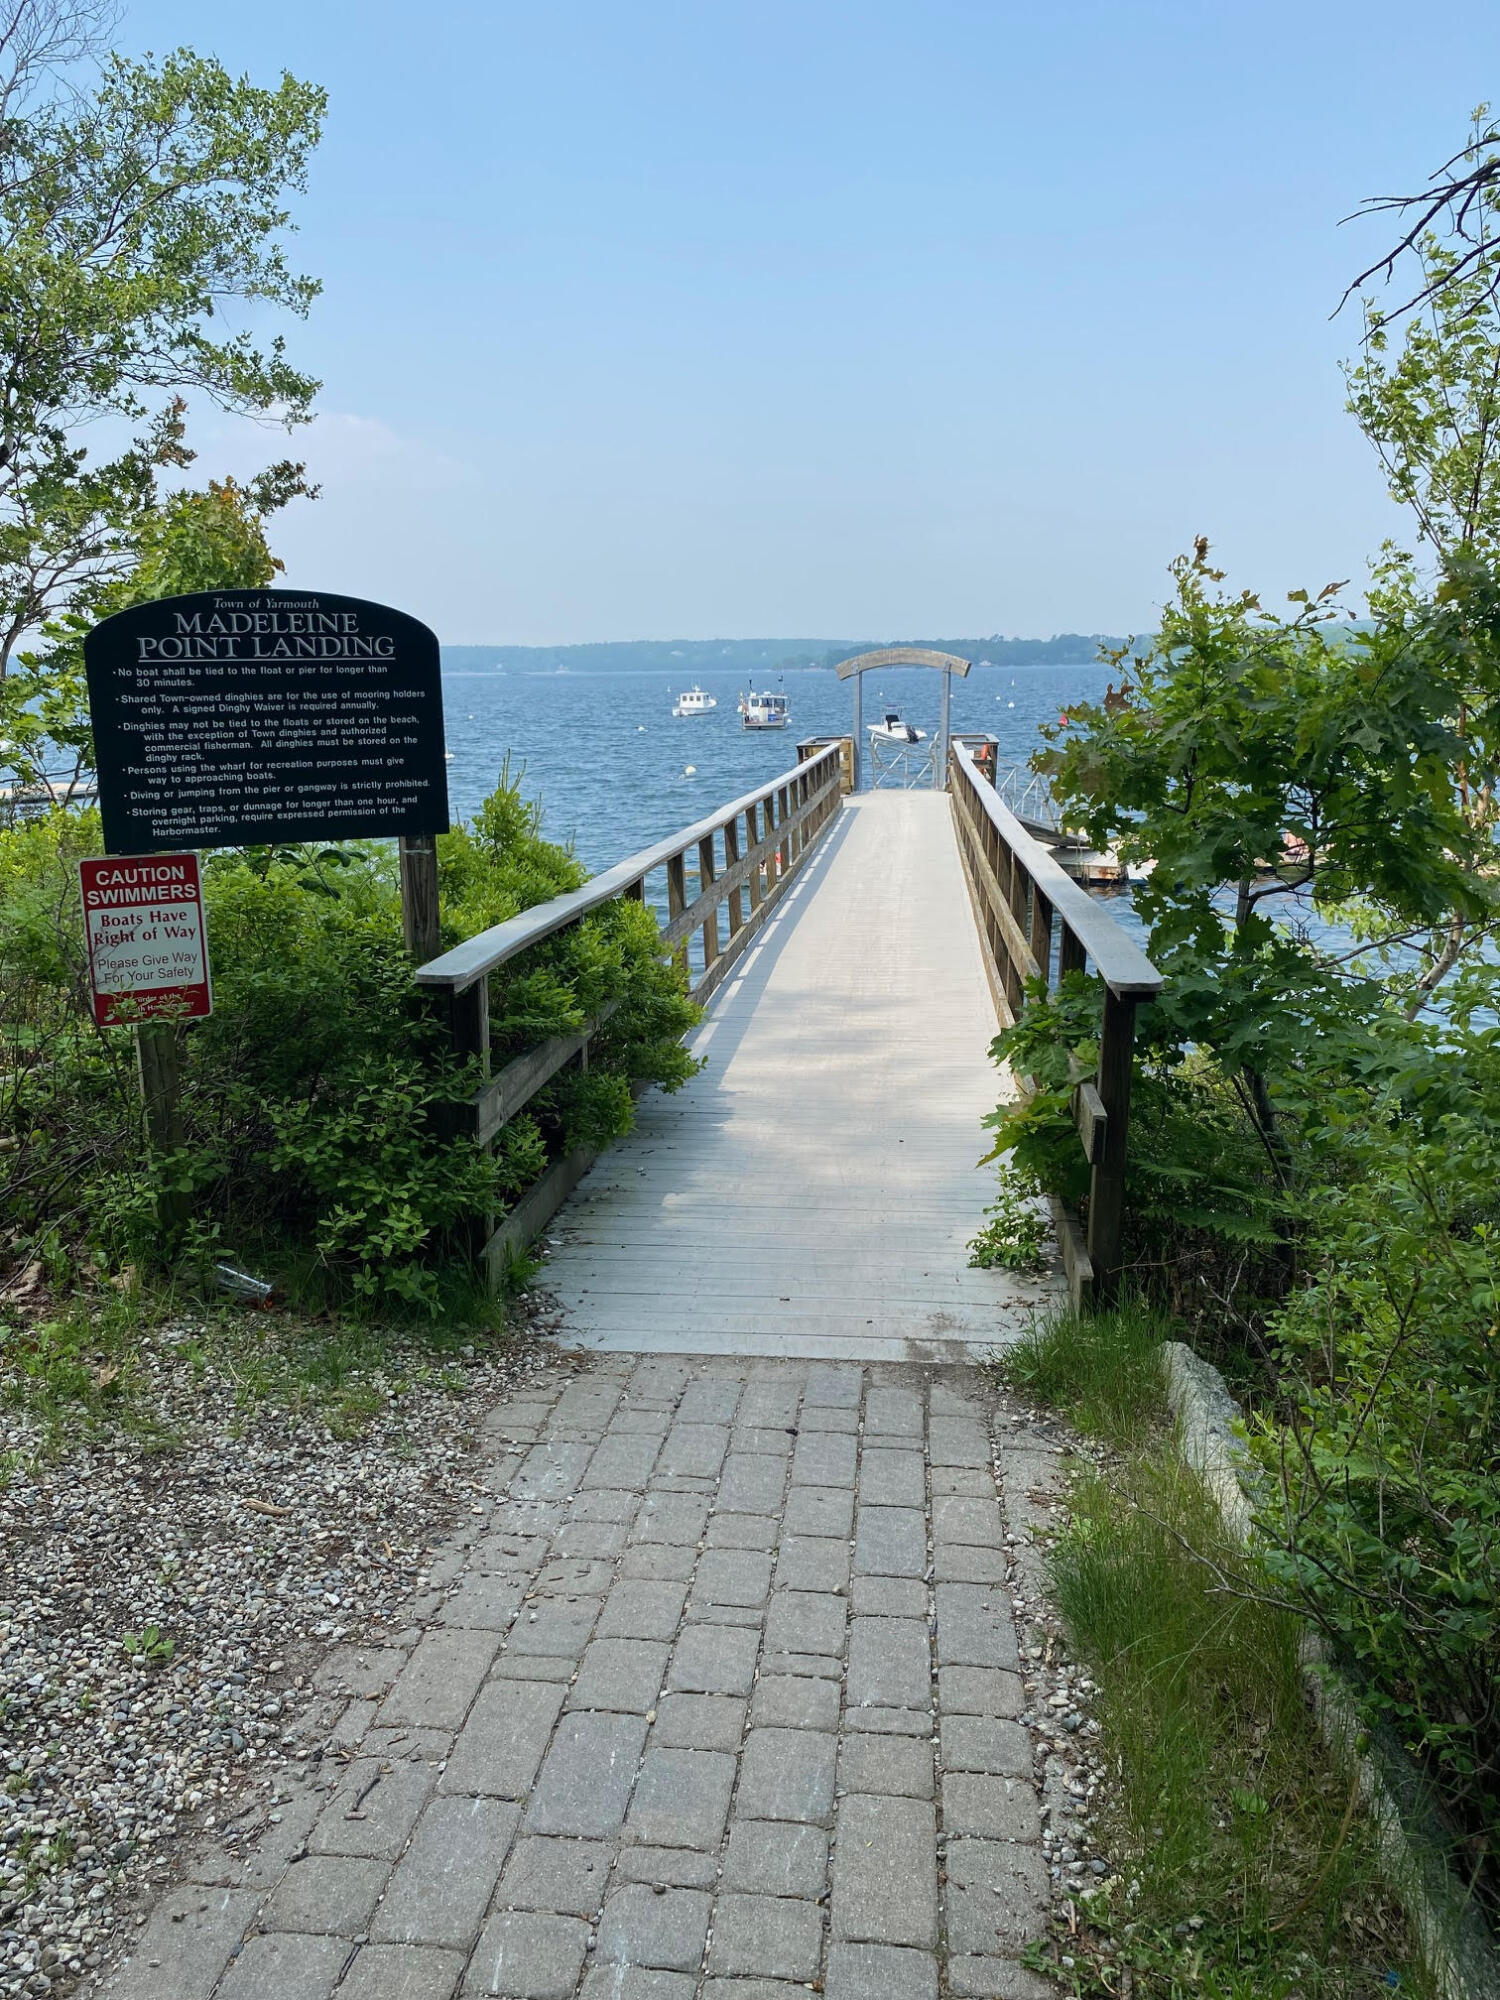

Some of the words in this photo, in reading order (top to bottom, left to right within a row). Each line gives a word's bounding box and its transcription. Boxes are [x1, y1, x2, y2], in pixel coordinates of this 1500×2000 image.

[215, 597, 244, 608] Town
[248, 599, 260, 608] of
[266, 598, 319, 609] Yarmouth
[172, 613, 359, 634] MADELEINE
[136, 637, 241, 658] POINT
[251, 636, 395, 657] LANDING
[118, 668, 133, 677] No
[135, 667, 159, 677] boat
[162, 667, 186, 676] shall
[188, 667, 202, 676] be
[205, 667, 224, 675] tied
[227, 667, 238, 675] to
[241, 666, 257, 675] the
[260, 666, 282, 675] float
[298, 667, 316, 675] pier
[319, 666, 333, 674] for
[336, 665, 365, 675] longer
[367, 665, 388, 673] than
[136, 678, 150, 687] 30
[153, 678, 195, 687] minutes.
[120, 694, 157, 704] Shared
[159, 693, 221, 702] Town-owned
[224, 692, 264, 702] dinghies
[286, 692, 300, 700] for
[341, 691, 351, 699] of
[354, 691, 390, 700] mooring
[393, 690, 426, 698] holders
[140, 705, 165, 715] only.
[172, 705, 180, 713] A
[183, 704, 216, 714] signed
[218, 703, 251, 714] Dinghy
[253, 703, 285, 711] Waiver
[299, 702, 337, 711] required
[340, 701, 379, 710] annually.
[123, 721, 166, 732] Dinghies
[169, 722, 190, 730] may
[192, 720, 209, 729] not
[212, 720, 225, 728] be
[228, 719, 247, 728] tied
[250, 719, 261, 727] to
[263, 718, 279, 727] the
[282, 718, 310, 726] floats
[326, 716, 355, 725] stored
[373, 716, 388, 724] the
[390, 715, 420, 724] beach,
[143, 730, 165, 741] with
[167, 732, 184, 741] the
[187, 730, 235, 741] exception
[238, 729, 248, 738] of
[251, 729, 276, 738] Town
[278, 728, 317, 738] dinghies
[319, 727, 337, 736] and
[340, 726, 387, 735] authorized
[144, 742, 201, 752] commercial
[203, 741, 253, 750] fisherman.
[260, 740, 273, 748] All
[275, 739, 314, 749] dinghies
[316, 738, 340, 746] must
[342, 738, 354, 746] be
[357, 736, 387, 745] stored
[403, 736, 418, 744] the
[127, 766, 168, 775] Persons
[170, 764, 197, 774] using
[200, 763, 216, 772] the
[219, 762, 246, 771] wharf
[249, 761, 264, 770] for
[266, 760, 313, 769] recreation
[316, 759, 359, 768] purposes
[386, 757, 405, 767] give
[145, 753, 178, 764] dinghy
[181, 752, 205, 761] rack.
[147, 777, 167, 786] way
[170, 775, 182, 784] to
[184, 773, 244, 784] approaching
[246, 772, 276, 780] boats.
[130, 791, 161, 801] Diving
[178, 788, 216, 799] jumping
[218, 787, 241, 795] from
[244, 786, 260, 794] the
[262, 785, 281, 795] pier
[297, 784, 337, 794] gangway
[351, 780, 382, 790] strictly
[385, 779, 431, 789] prohibited.
[131, 807, 168, 817] Storing
[170, 807, 196, 816] gear,
[198, 805, 226, 814] traps,
[243, 802, 283, 811] dunnage
[286, 801, 299, 809] for
[302, 800, 331, 809] longer
[334, 798, 354, 807] than
[376, 797, 399, 805] hour,
[401, 795, 418, 804] and
[151, 814, 197, 826] overnight
[199, 814, 238, 825] parking,
[241, 812, 274, 822] require
[276, 809, 325, 820] expressed
[327, 807, 376, 818] permission
[379, 806, 388, 815] of
[391, 806, 406, 814] the
[152, 826, 221, 836] Harbormaster.
[95, 865, 185, 886] CAUTION
[87, 884, 197, 905] SWIMMERS
[101, 913, 143, 928] Boats
[150, 911, 188, 923] Have
[94, 930, 136, 947] Right
[142, 928, 157, 941] of
[164, 925, 196, 940] Way
[98, 957, 138, 970] Please
[142, 954, 169, 966] Give
[172, 952, 197, 964] Way
[104, 973, 124, 984] For
[128, 970, 154, 982] Your
[158, 966, 194, 979] Safety
